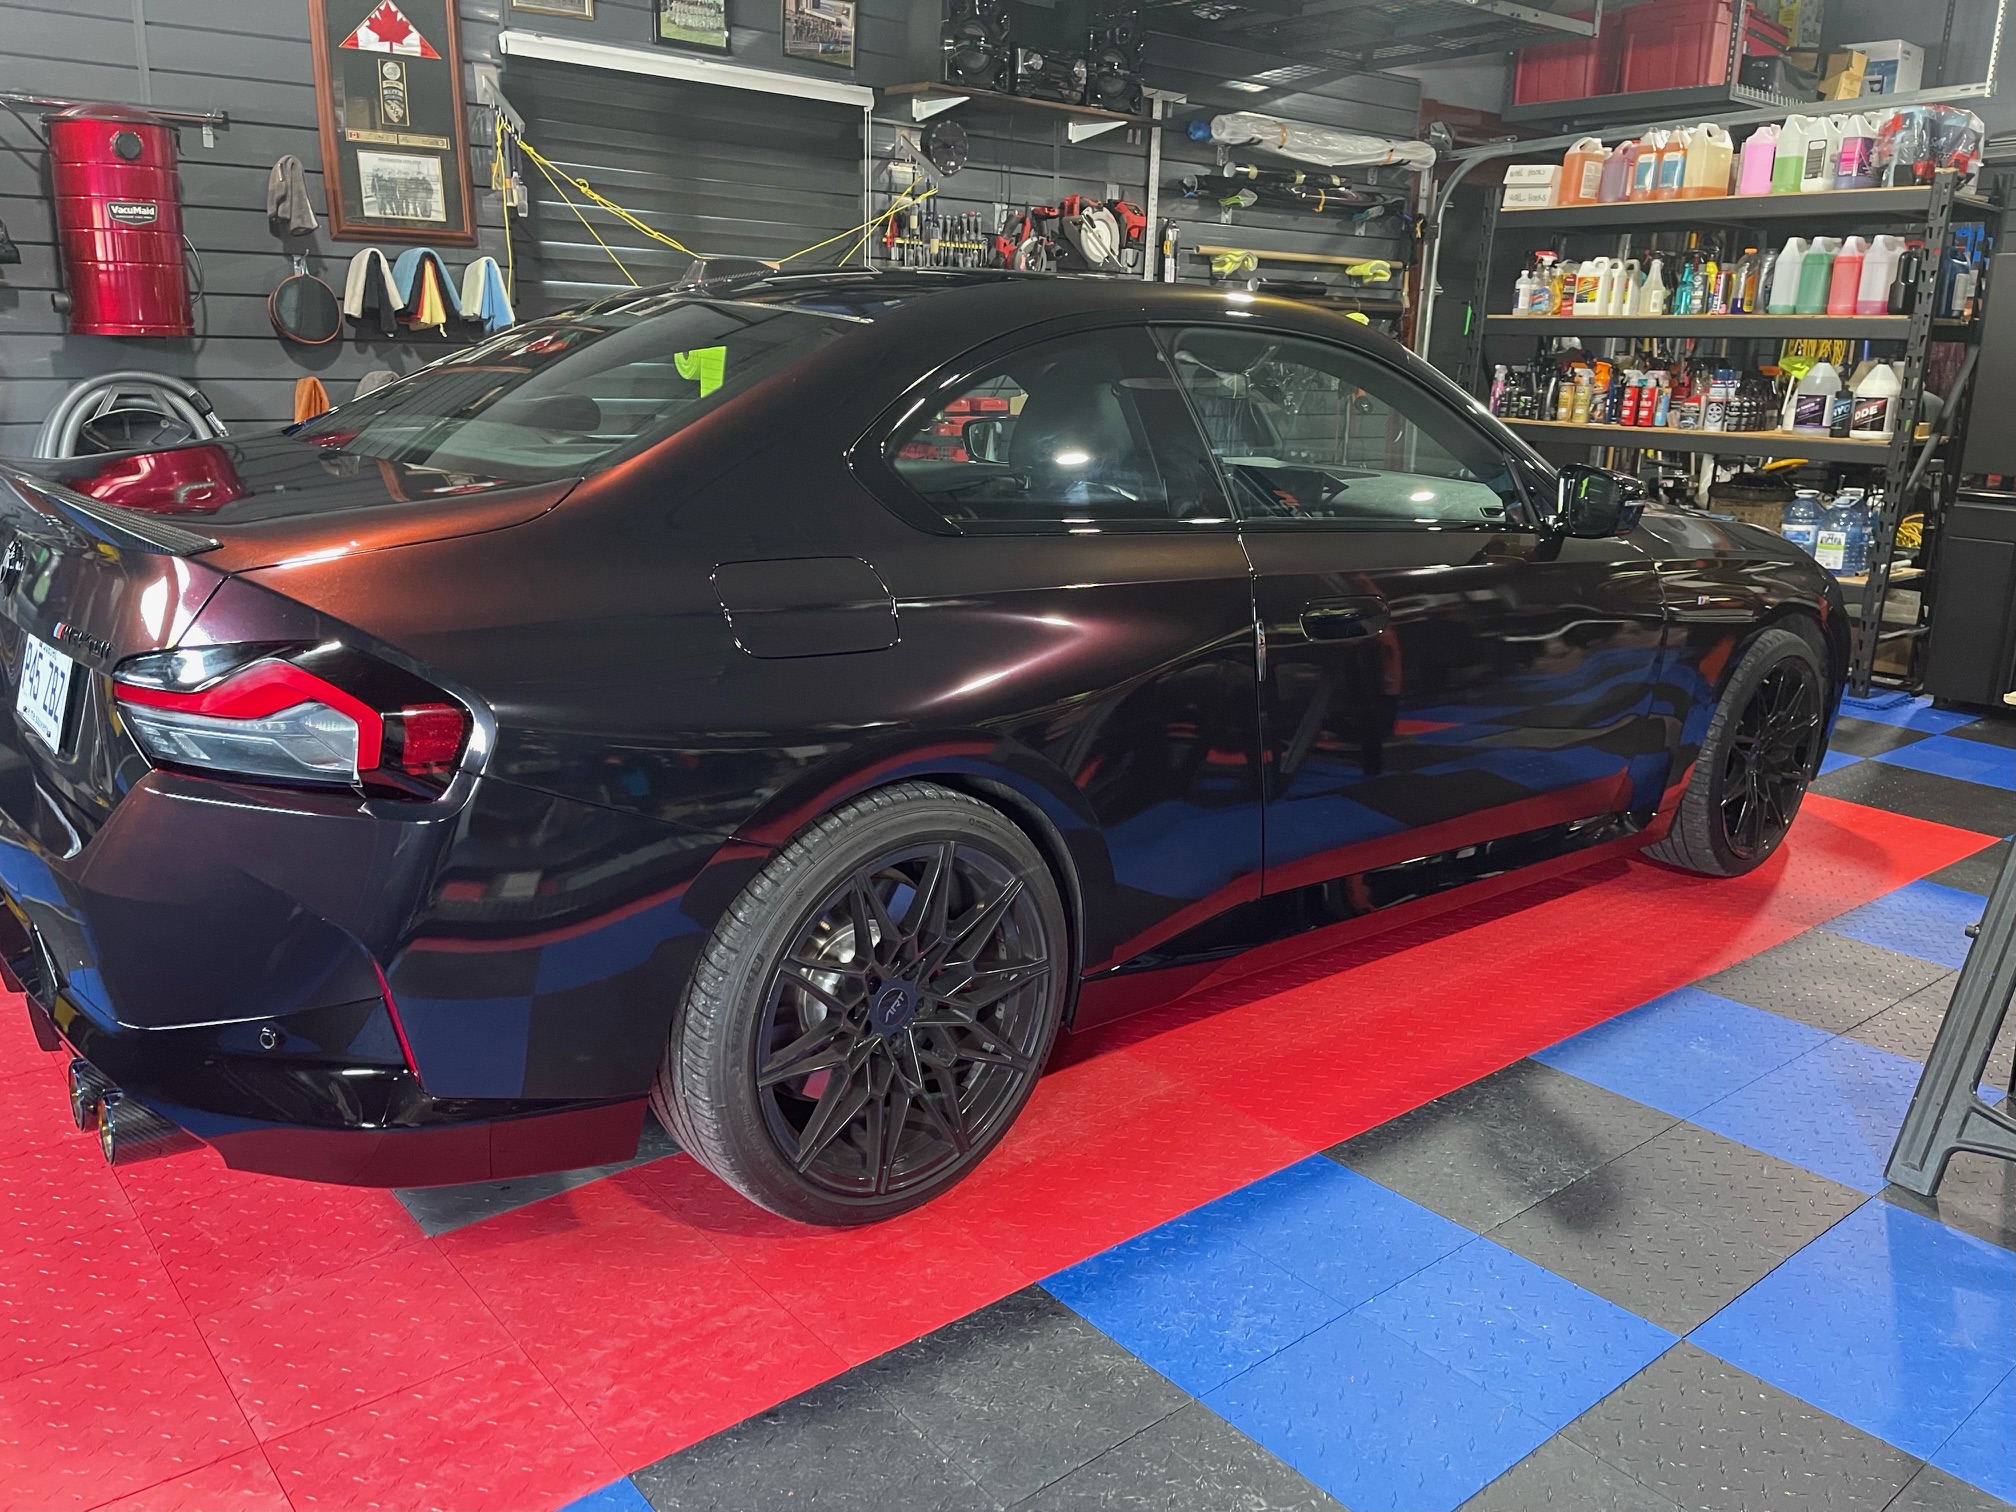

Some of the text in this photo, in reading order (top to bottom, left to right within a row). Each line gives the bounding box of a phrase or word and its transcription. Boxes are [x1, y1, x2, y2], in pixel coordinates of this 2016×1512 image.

[110, 205, 155, 215] VacuMaid
[22, 641, 43, 701] P45
[43, 660, 66, 724] ZBZ
